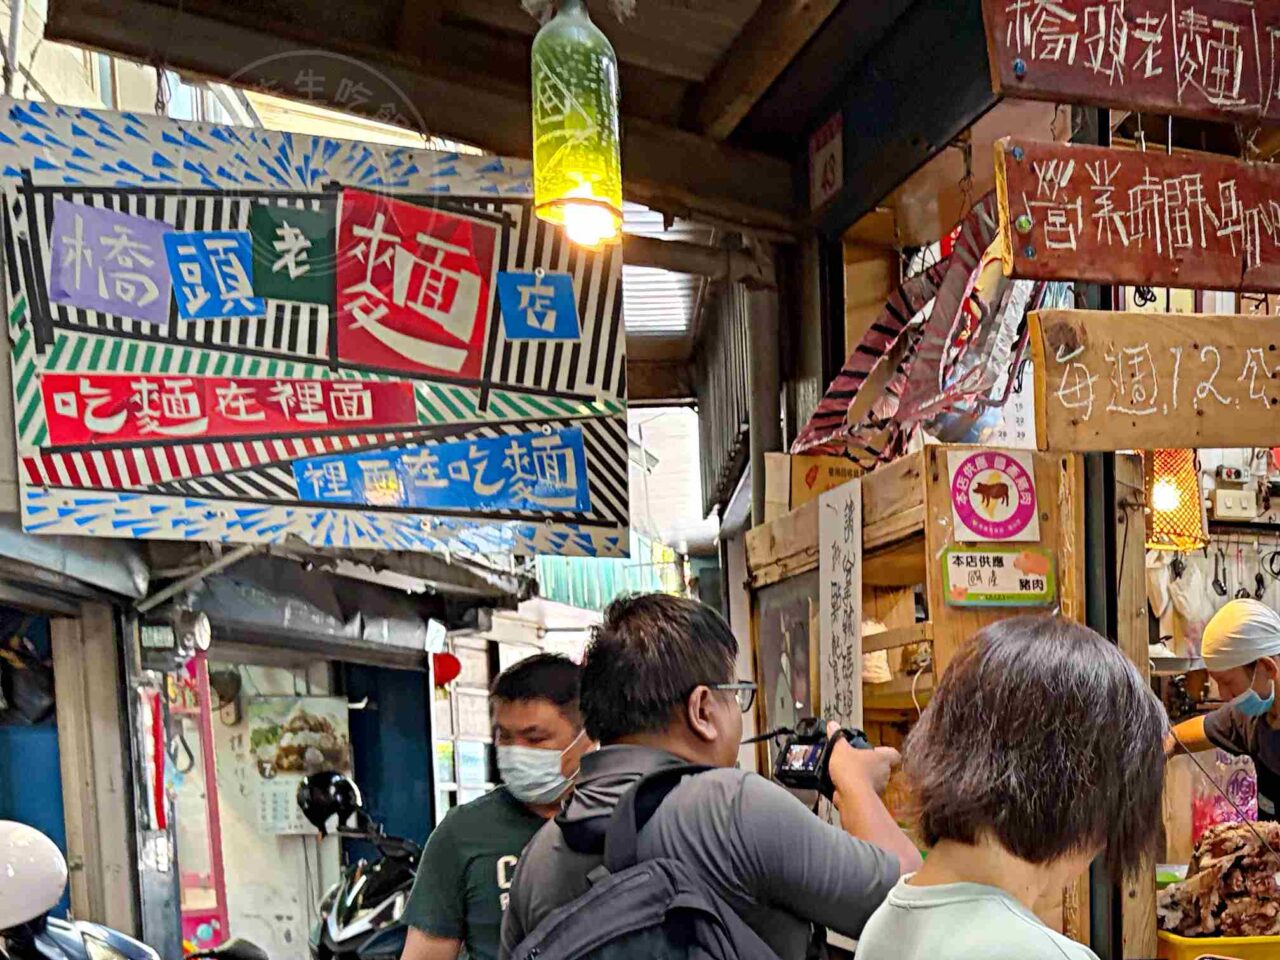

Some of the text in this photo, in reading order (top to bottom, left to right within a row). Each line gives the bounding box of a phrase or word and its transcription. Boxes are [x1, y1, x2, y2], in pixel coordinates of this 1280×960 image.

[61, 212, 558, 373] 橋頭老麵店
[53, 378, 373, 435] 吃麵在裡面
[304, 434, 578, 507] 裡面在吃麵
